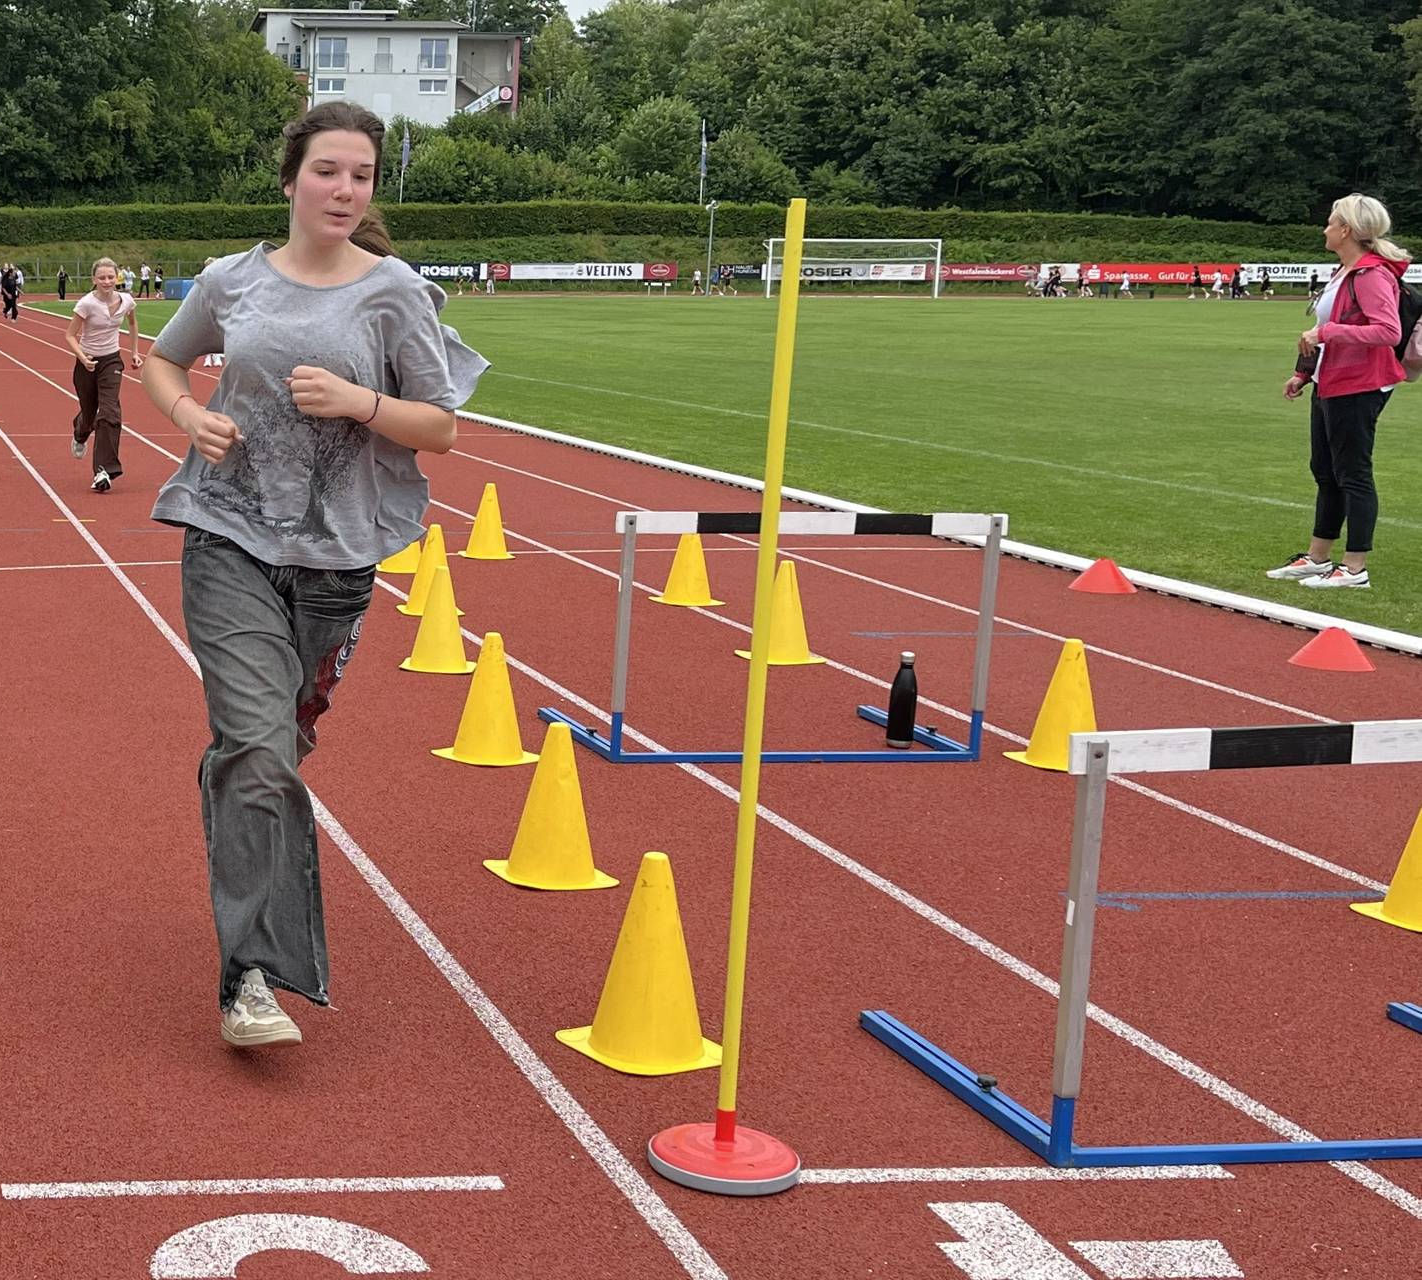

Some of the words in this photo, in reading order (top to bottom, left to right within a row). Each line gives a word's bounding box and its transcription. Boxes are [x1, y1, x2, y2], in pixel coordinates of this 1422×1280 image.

[586, 265, 633, 277] VELTINS
[800, 267, 852, 277] OSIER
[952, 267, 1016, 275] Westfalenbäckerei
[1257, 266, 1308, 274] PROTIME
[1158, 271, 1175, 280] Gut
[1175, 271, 1190, 280] für
